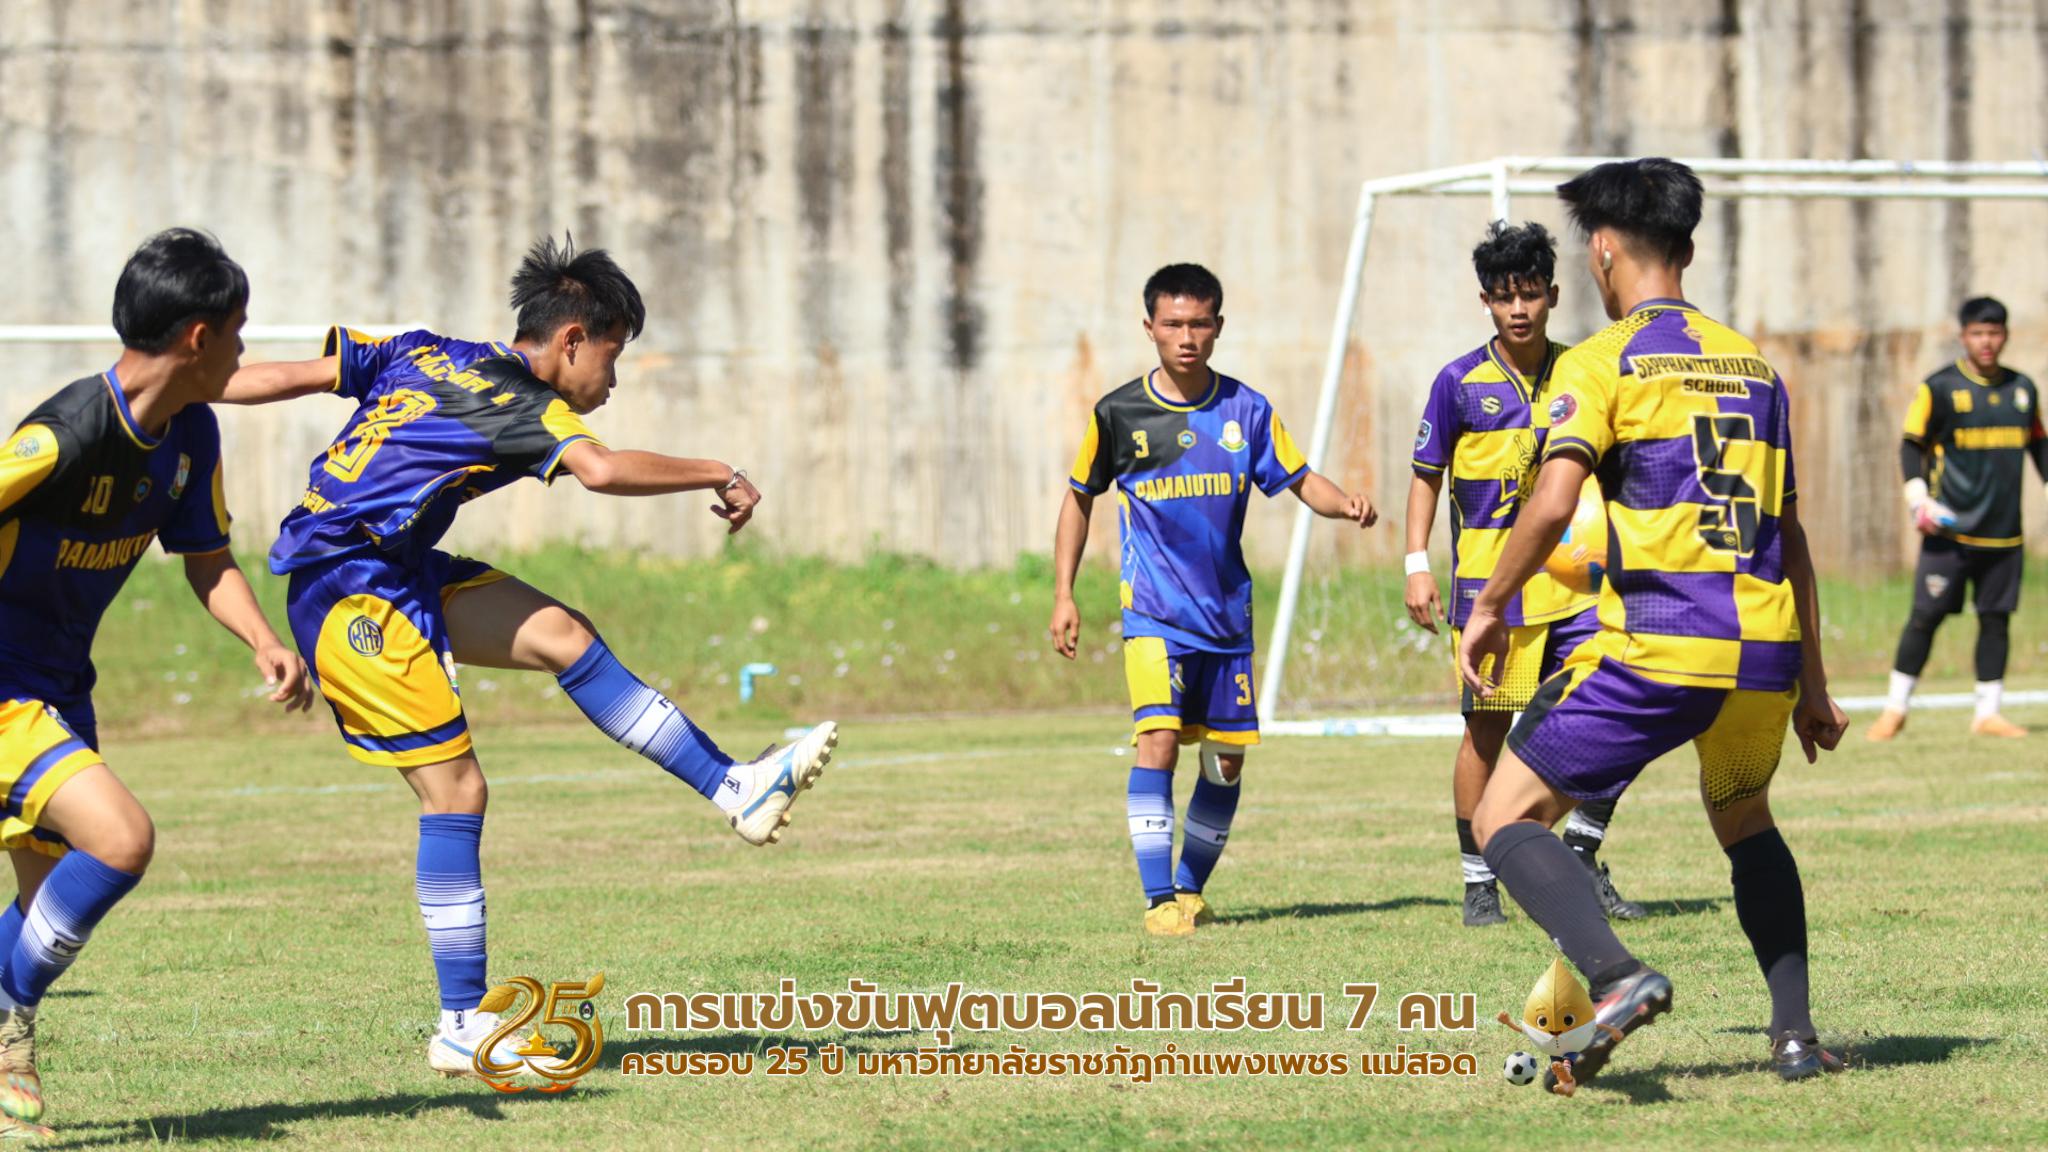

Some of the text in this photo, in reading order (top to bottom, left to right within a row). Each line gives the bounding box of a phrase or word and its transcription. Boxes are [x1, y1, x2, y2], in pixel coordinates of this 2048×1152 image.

[1683, 378, 1747, 395] SCHOOL
[1132, 430, 1149, 459] 3
[81, 475, 115, 514] 10
[1691, 412, 1760, 558] 5
[56, 529, 158, 570] PAMAIUTI
[1235, 673, 1251, 705] 3
